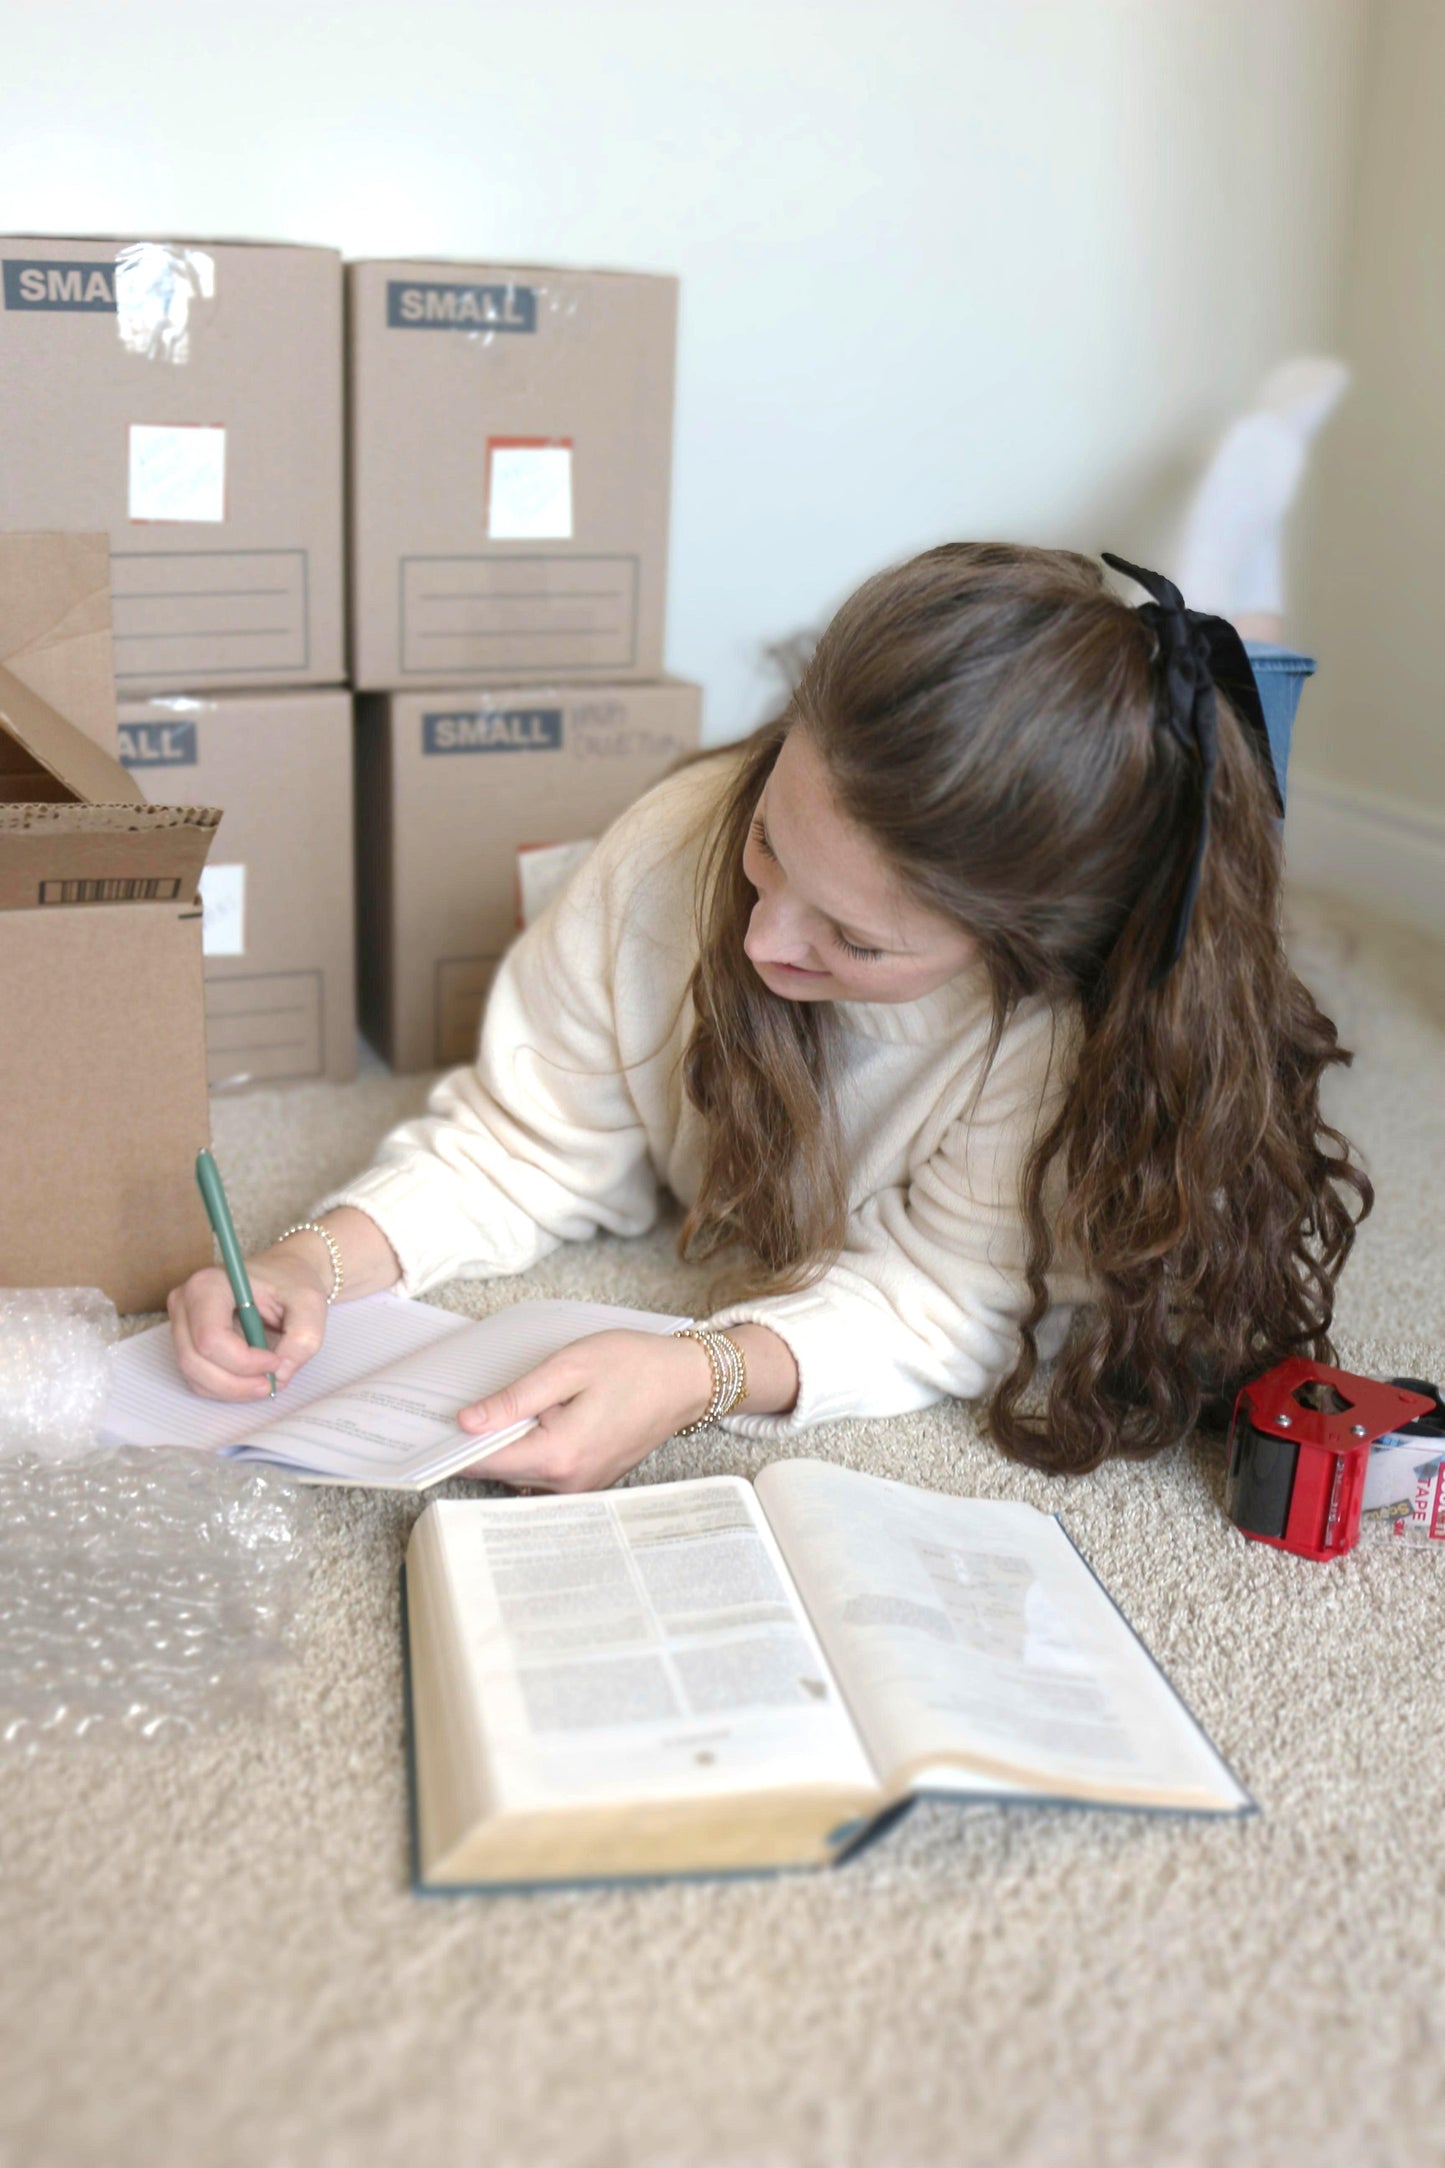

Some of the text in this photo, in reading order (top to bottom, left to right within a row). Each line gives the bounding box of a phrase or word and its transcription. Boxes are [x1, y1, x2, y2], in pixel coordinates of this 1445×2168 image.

[19, 269, 116, 302] SMA
[401, 289, 525, 325] SMALL
[119, 729, 184, 759] ALL
[434, 716, 550, 748] SMALL
[1412, 1478, 1432, 1521] TAPE
